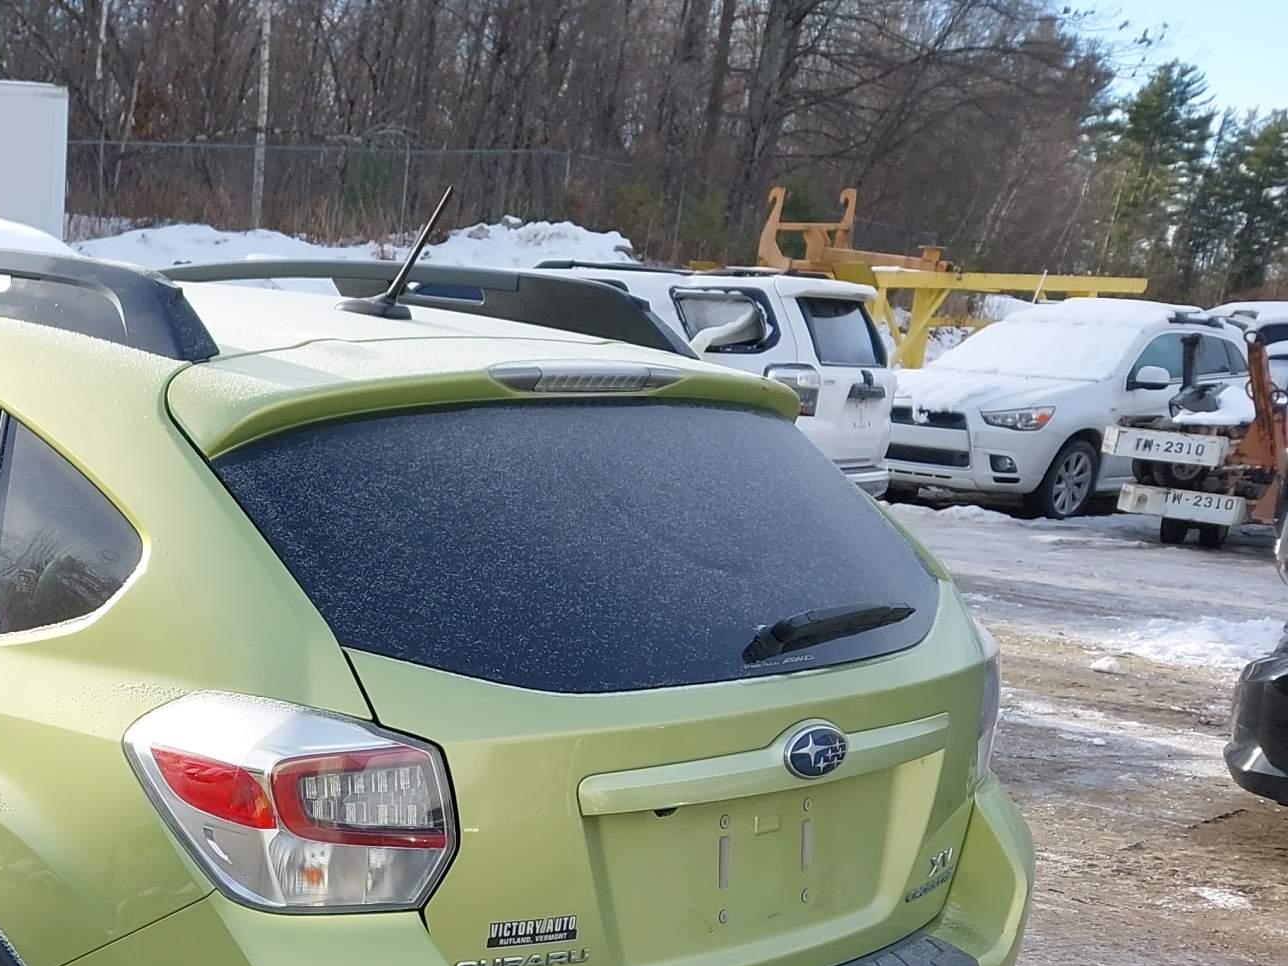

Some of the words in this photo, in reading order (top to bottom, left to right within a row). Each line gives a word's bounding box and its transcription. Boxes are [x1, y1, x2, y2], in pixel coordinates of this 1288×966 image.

[491, 919, 544, 938] VICTORY
[546, 915, 576, 932] AUTO
[535, 932, 568, 942] VERMONT
